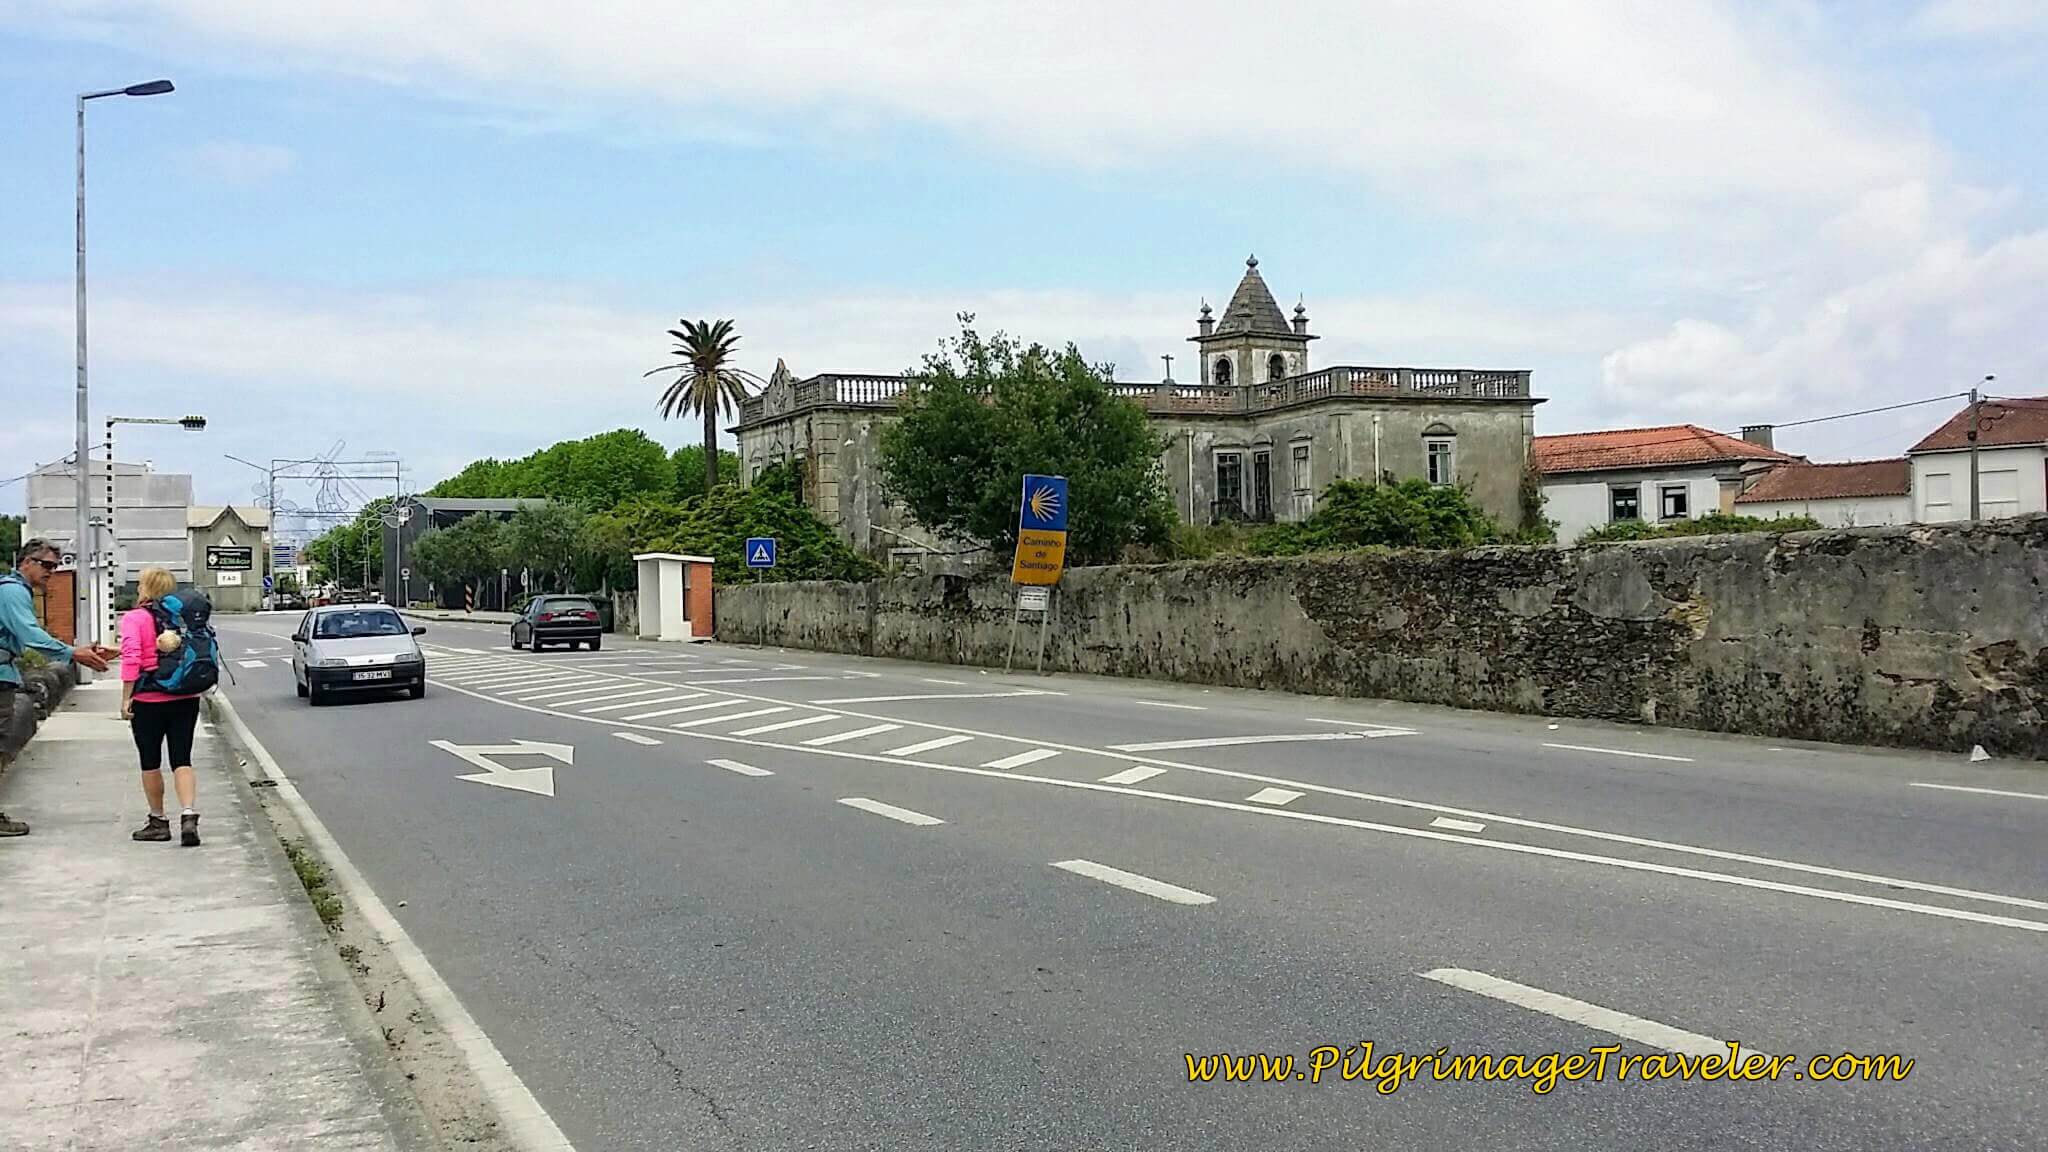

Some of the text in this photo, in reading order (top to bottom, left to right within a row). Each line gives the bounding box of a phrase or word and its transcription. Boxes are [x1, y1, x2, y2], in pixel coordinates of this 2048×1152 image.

[1023, 536, 1062, 548] Caminho
[1035, 551, 1047, 559] de
[1020, 560, 1059, 572] Santiago
